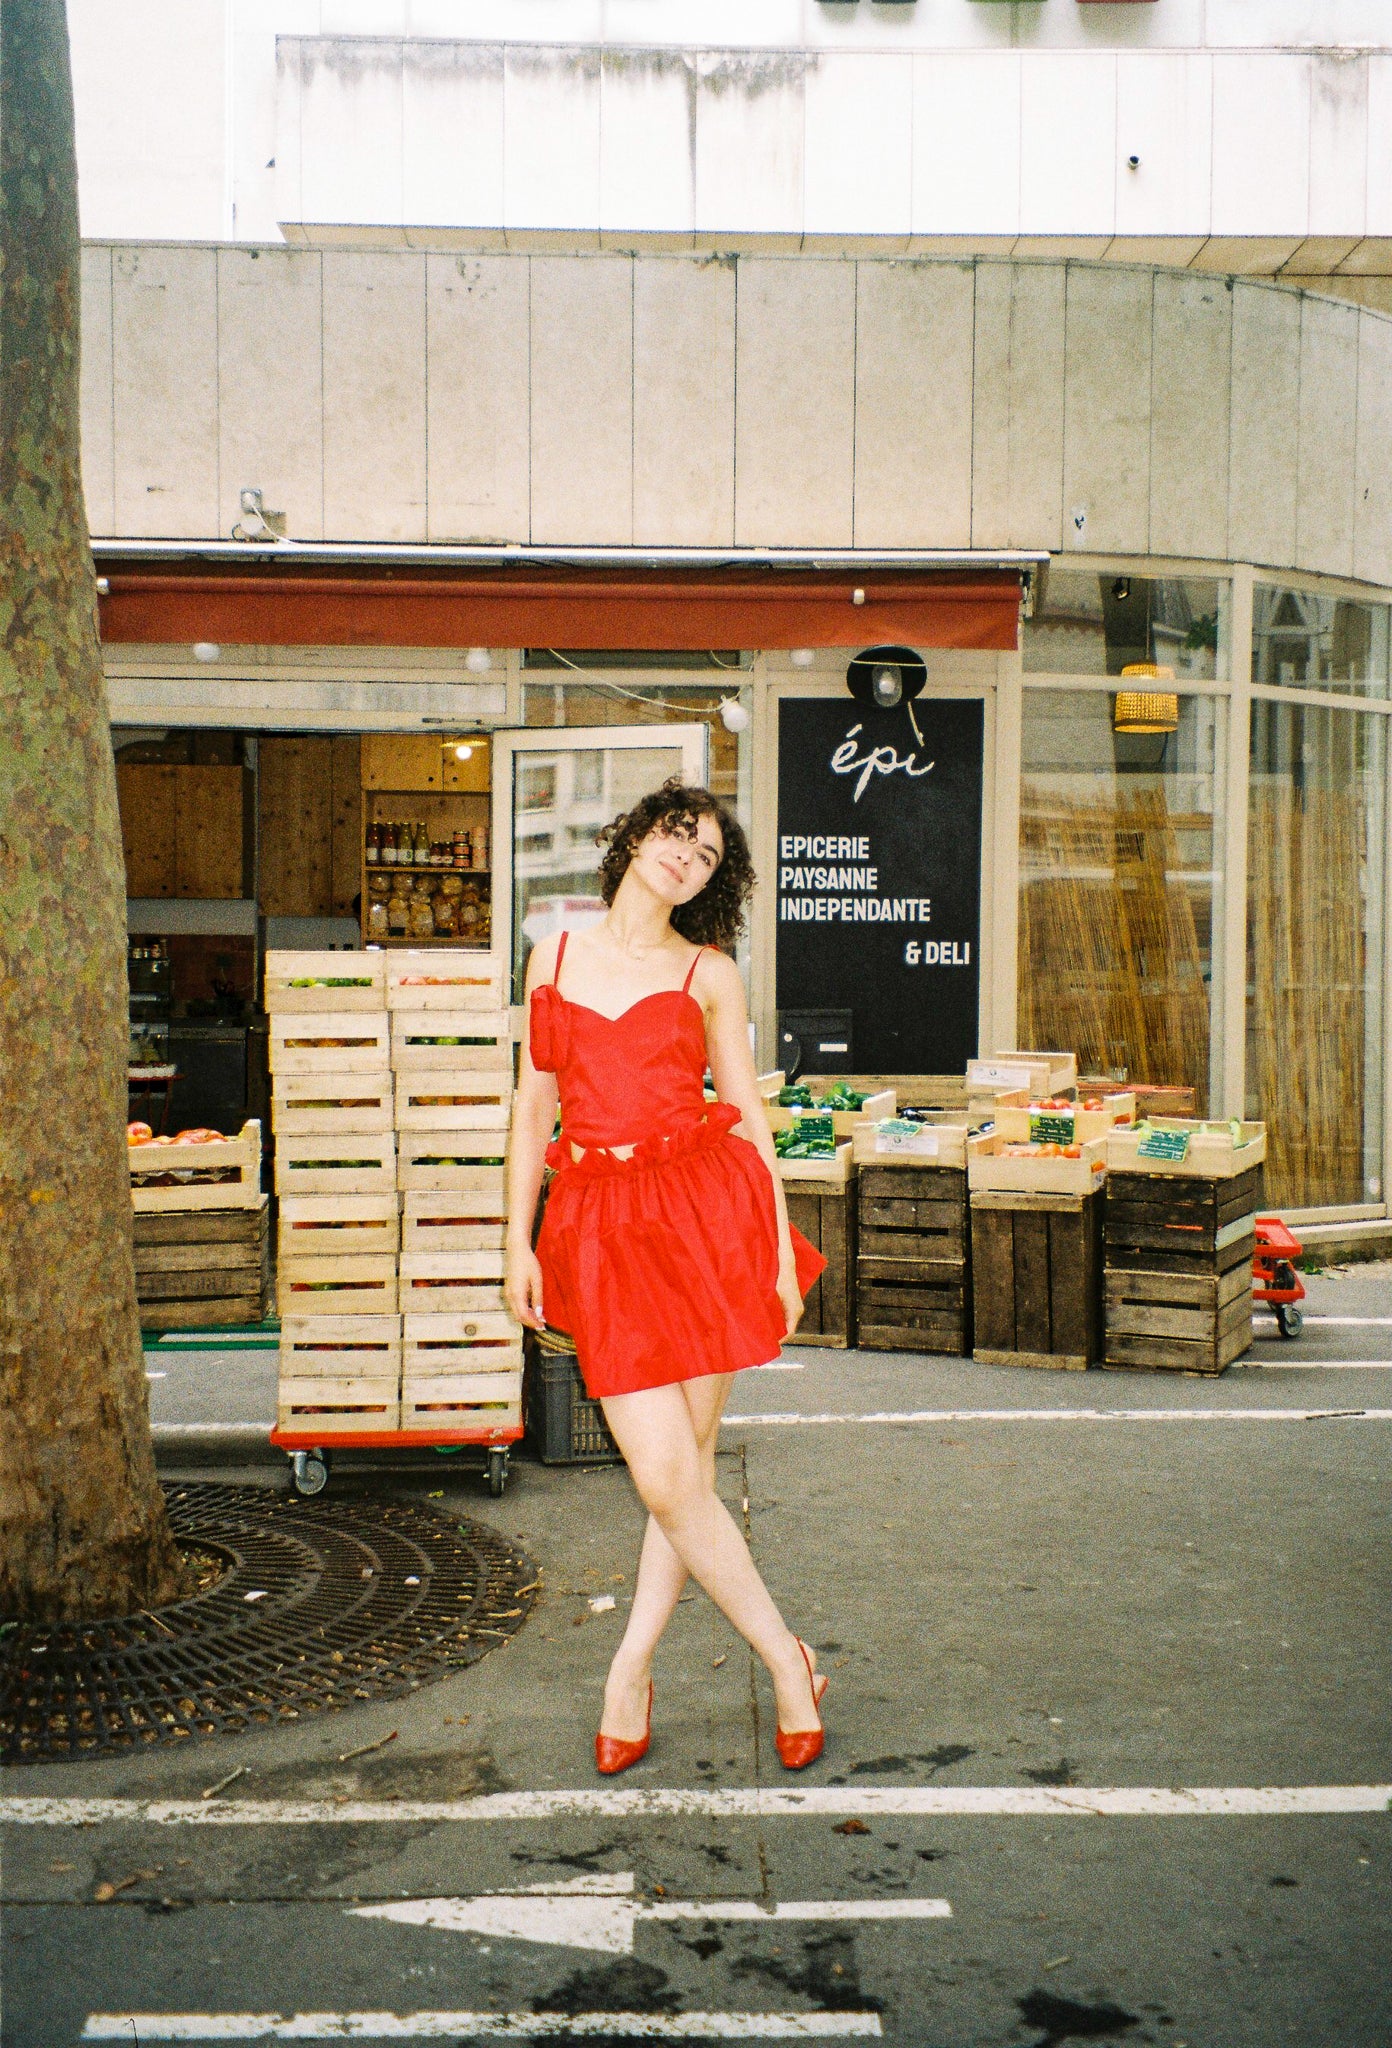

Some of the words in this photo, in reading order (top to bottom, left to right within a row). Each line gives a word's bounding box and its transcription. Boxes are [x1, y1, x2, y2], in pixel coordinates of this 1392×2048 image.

[830, 723, 935, 803] épi
[780, 835, 870, 859] EPICERIE
[780, 867, 878, 890] PAYSANNE
[780, 898, 931, 922] INDEPENDANTE
